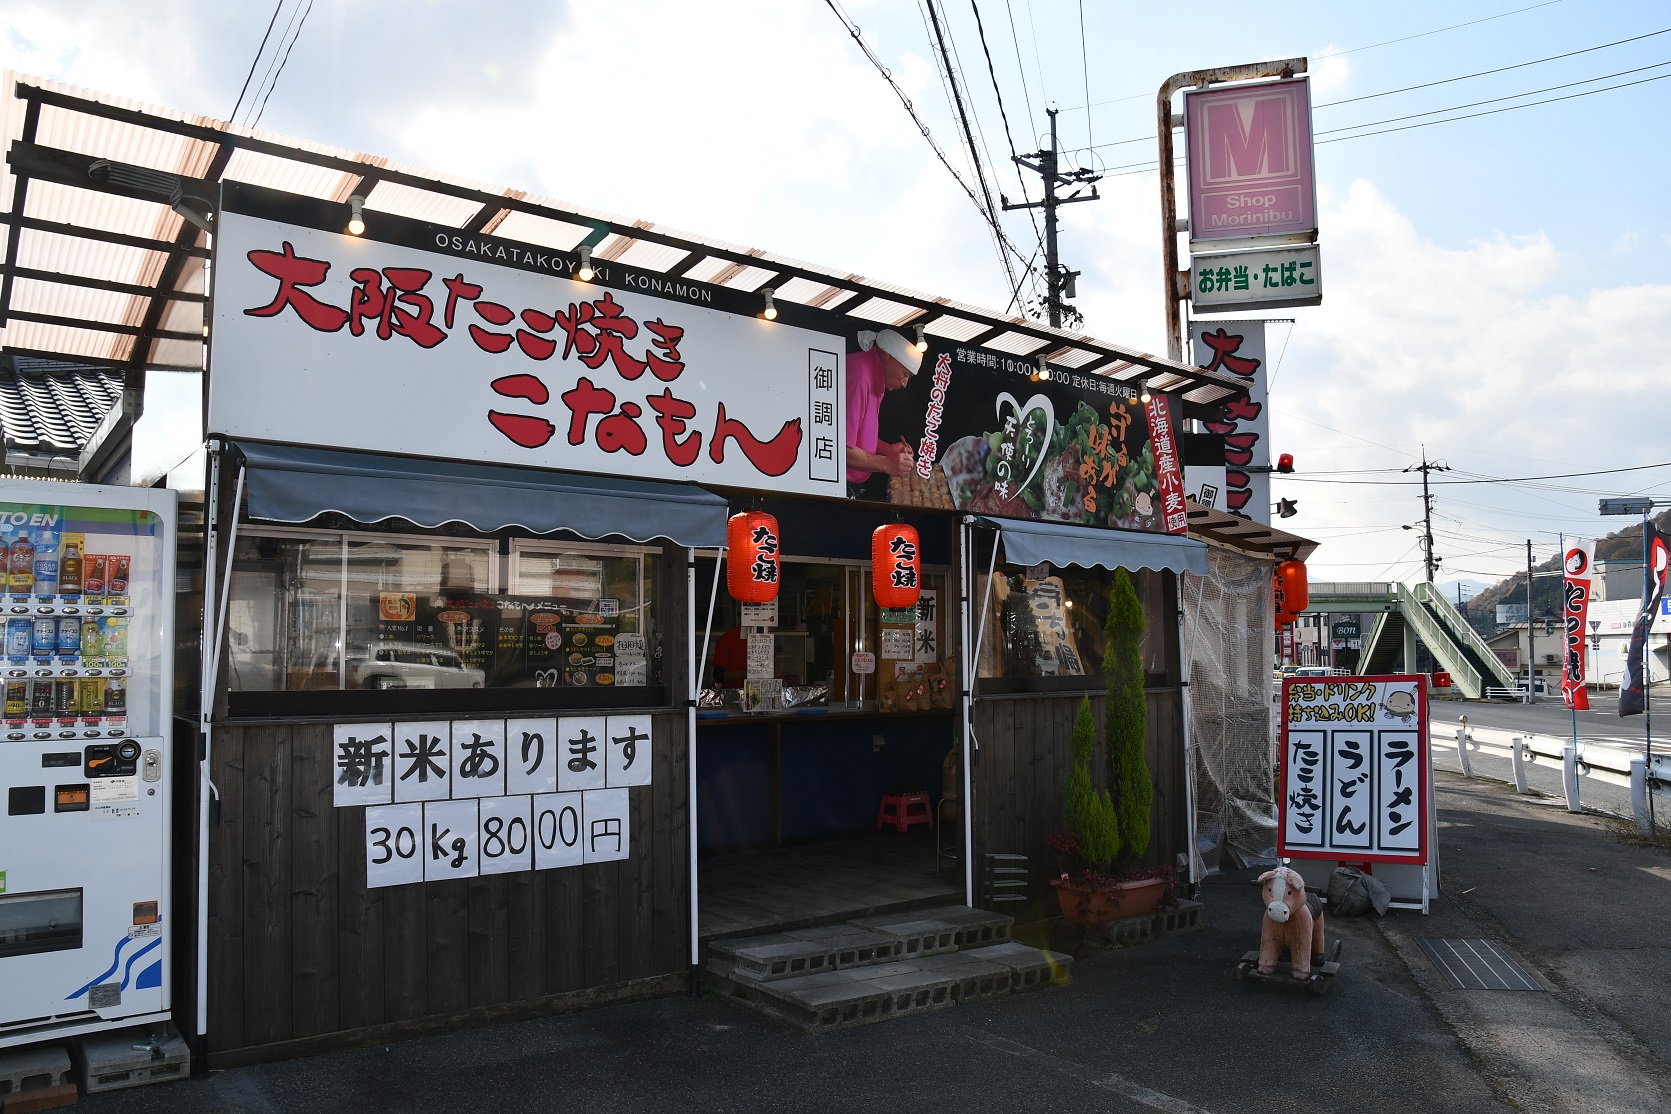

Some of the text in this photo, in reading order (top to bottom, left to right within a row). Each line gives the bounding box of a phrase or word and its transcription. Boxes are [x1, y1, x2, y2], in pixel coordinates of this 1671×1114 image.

[1211, 209, 1293, 227] Morinibu
[1226, 194, 1276, 209] Shop
[435, 233, 711, 302] OSAKATAKOYKI KONAMON
[1198, 261, 1315, 293] お弁当・たばこ
[244, 240, 687, 382] 大阪たこ焼き
[488, 373, 803, 477] こなもん
[813, 365, 834, 461] 御調店
[994, 415, 1018, 500] 天使の味
[1149, 397, 1183, 513] 北海道産小麦
[29, 513, 58, 527] EN
[1167, 512, 1187, 530] 使用
[751, 526, 778, 584] たこ焼
[889, 535, 917, 589] たこ焼
[916, 595, 936, 654] 新米
[1287, 702, 1376, 723] 持ち込みOK!
[1288, 682, 1377, 702] 弁当・ドリンク
[337, 725, 651, 788] 新米あります
[1288, 739, 1322, 835] たこ焼き
[1335, 740, 1369, 836] うどん
[1384, 740, 1416, 837] ラーメン
